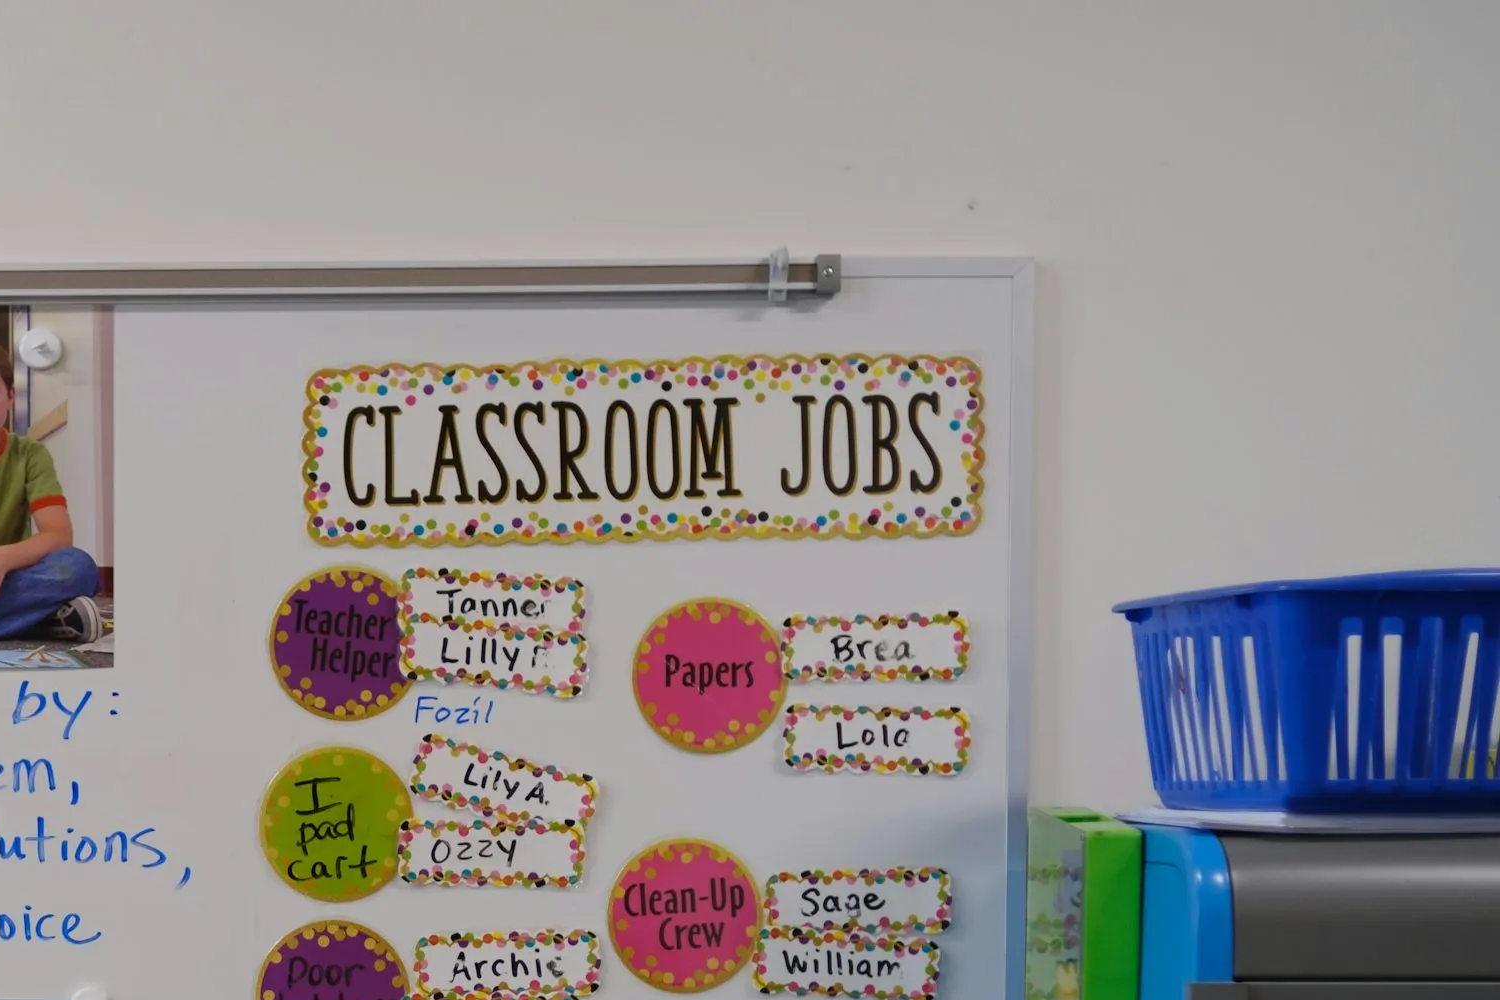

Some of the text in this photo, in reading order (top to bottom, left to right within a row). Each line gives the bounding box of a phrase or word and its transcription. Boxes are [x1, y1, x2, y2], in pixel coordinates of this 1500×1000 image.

[342, 391, 944, 506] CLASSROOM JOBS
[294, 598, 392, 642] Teacher
[436, 588, 551, 619] Tanner
[310, 636, 396, 683] Helper
[441, 636, 521, 672] Lilly
[830, 634, 915, 663] Brea
[664, 653, 756, 695] Papers
[294, 776, 342, 816] I
[463, 762, 520, 801] Lily
[297, 802, 357, 856] pad
[287, 845, 378, 883] cart
[623, 877, 746, 918] Clean-Up
[658, 917, 726, 951] Crew
[287, 955, 366, 990] Door
[451, 948, 565, 983] Archie
[782, 948, 901, 979] William
